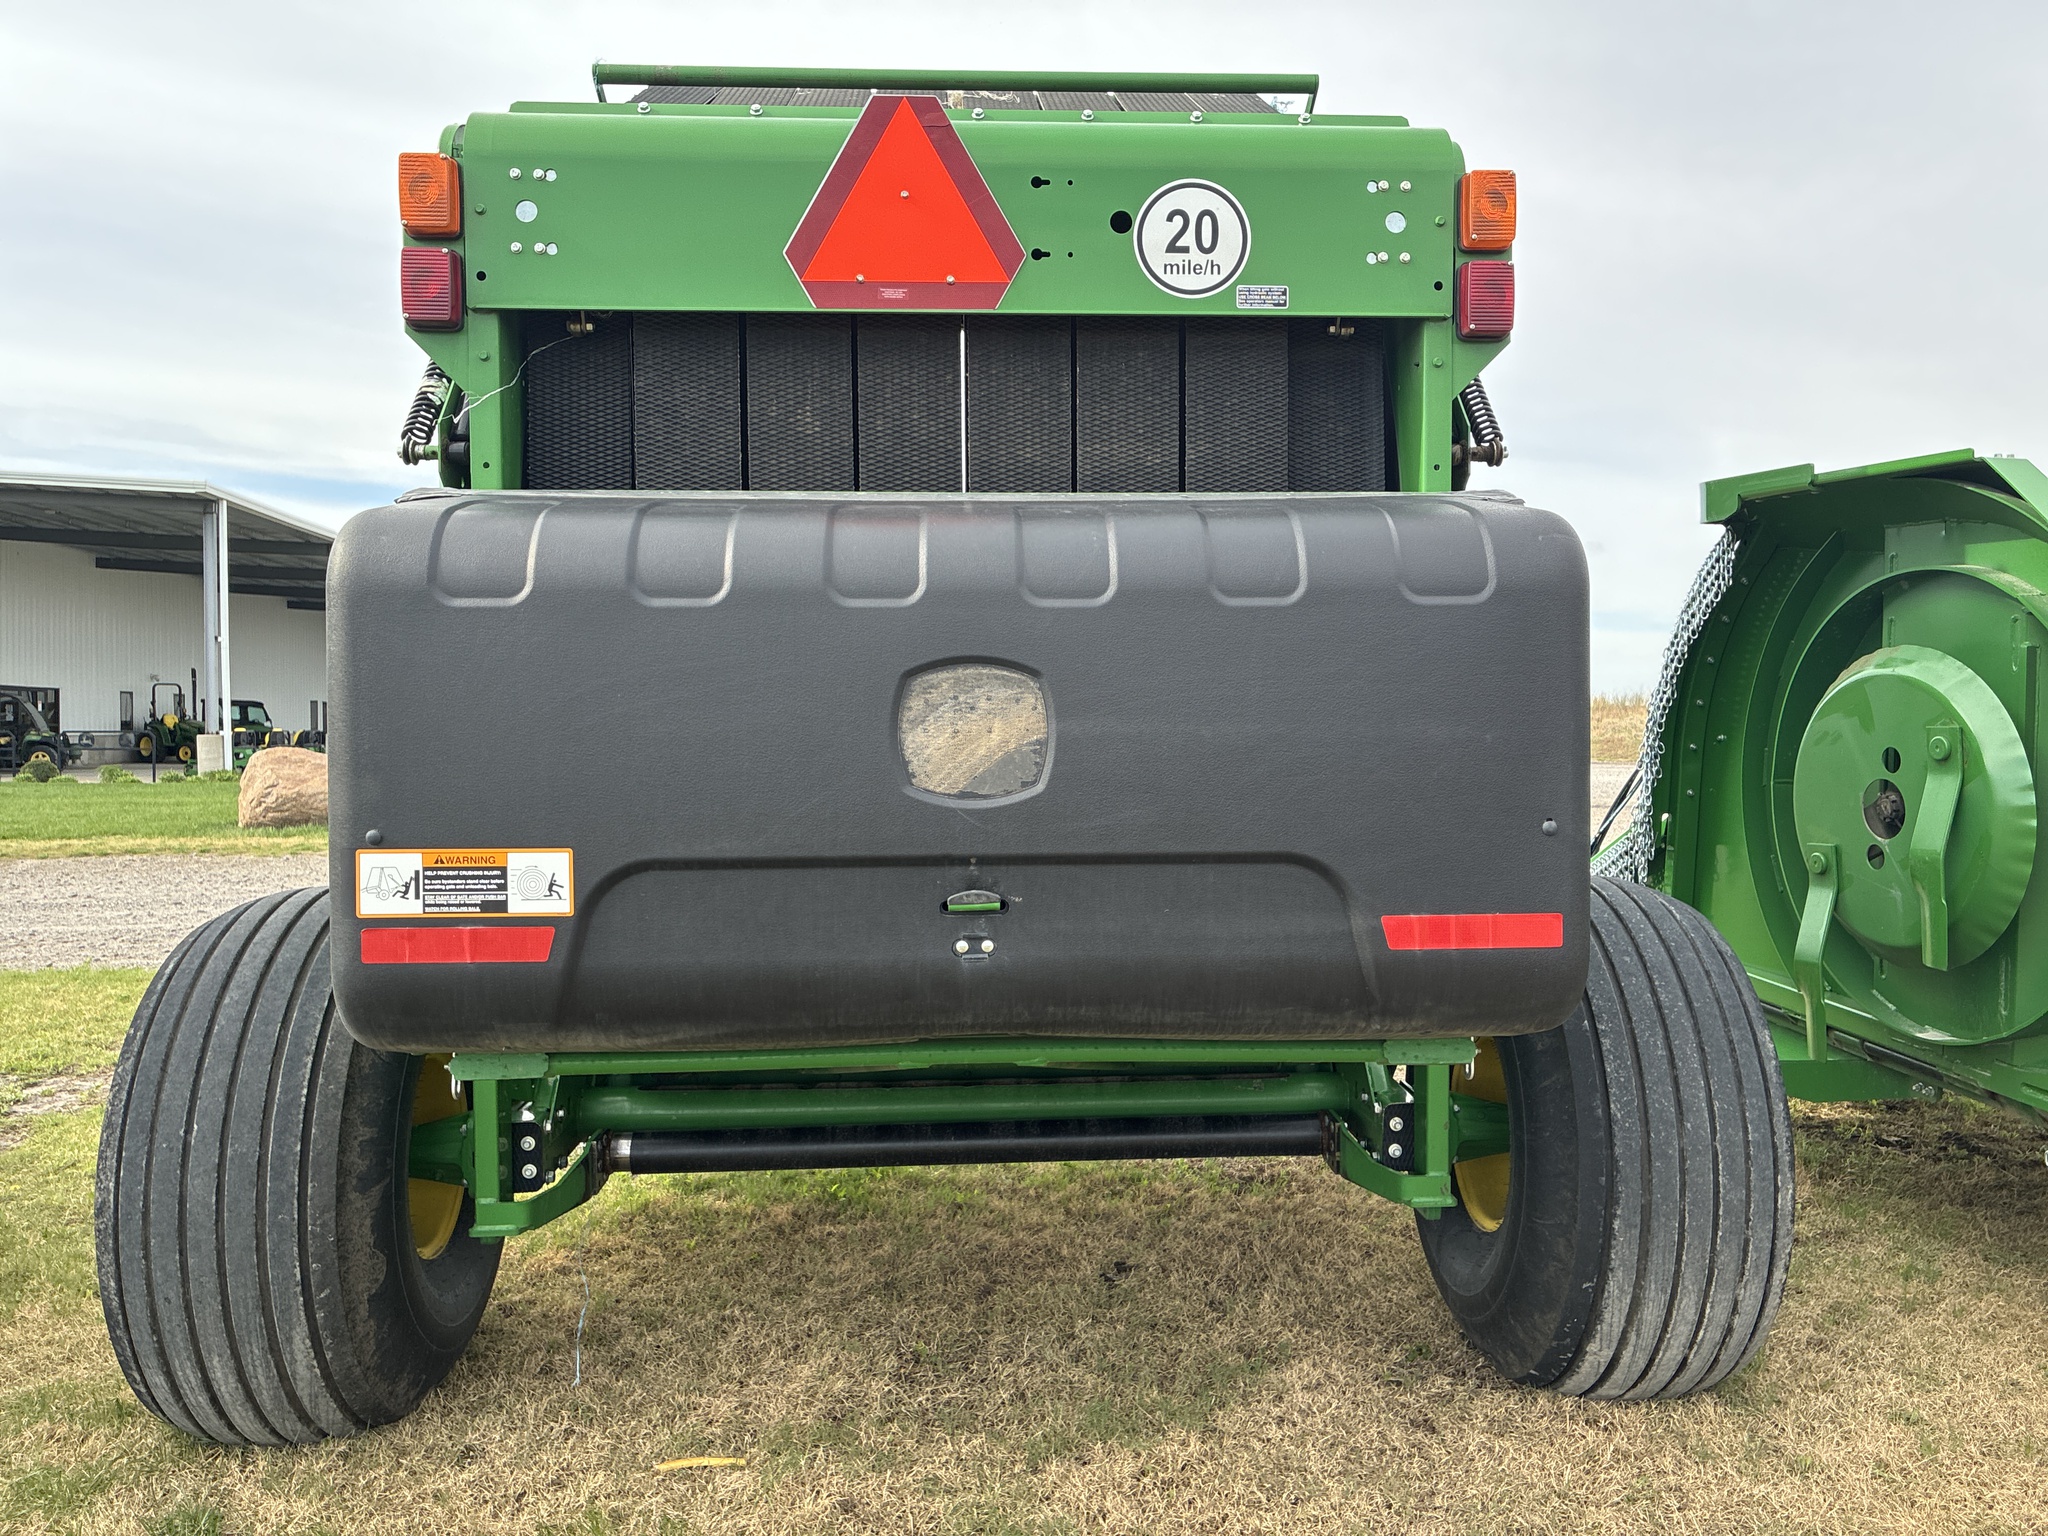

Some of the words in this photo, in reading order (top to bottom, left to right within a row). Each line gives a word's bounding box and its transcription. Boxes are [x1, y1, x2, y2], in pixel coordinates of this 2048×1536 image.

[1164, 208, 1220, 255] 20
[1163, 259, 1221, 276] mile/h
[445, 856, 496, 864] WARNING
